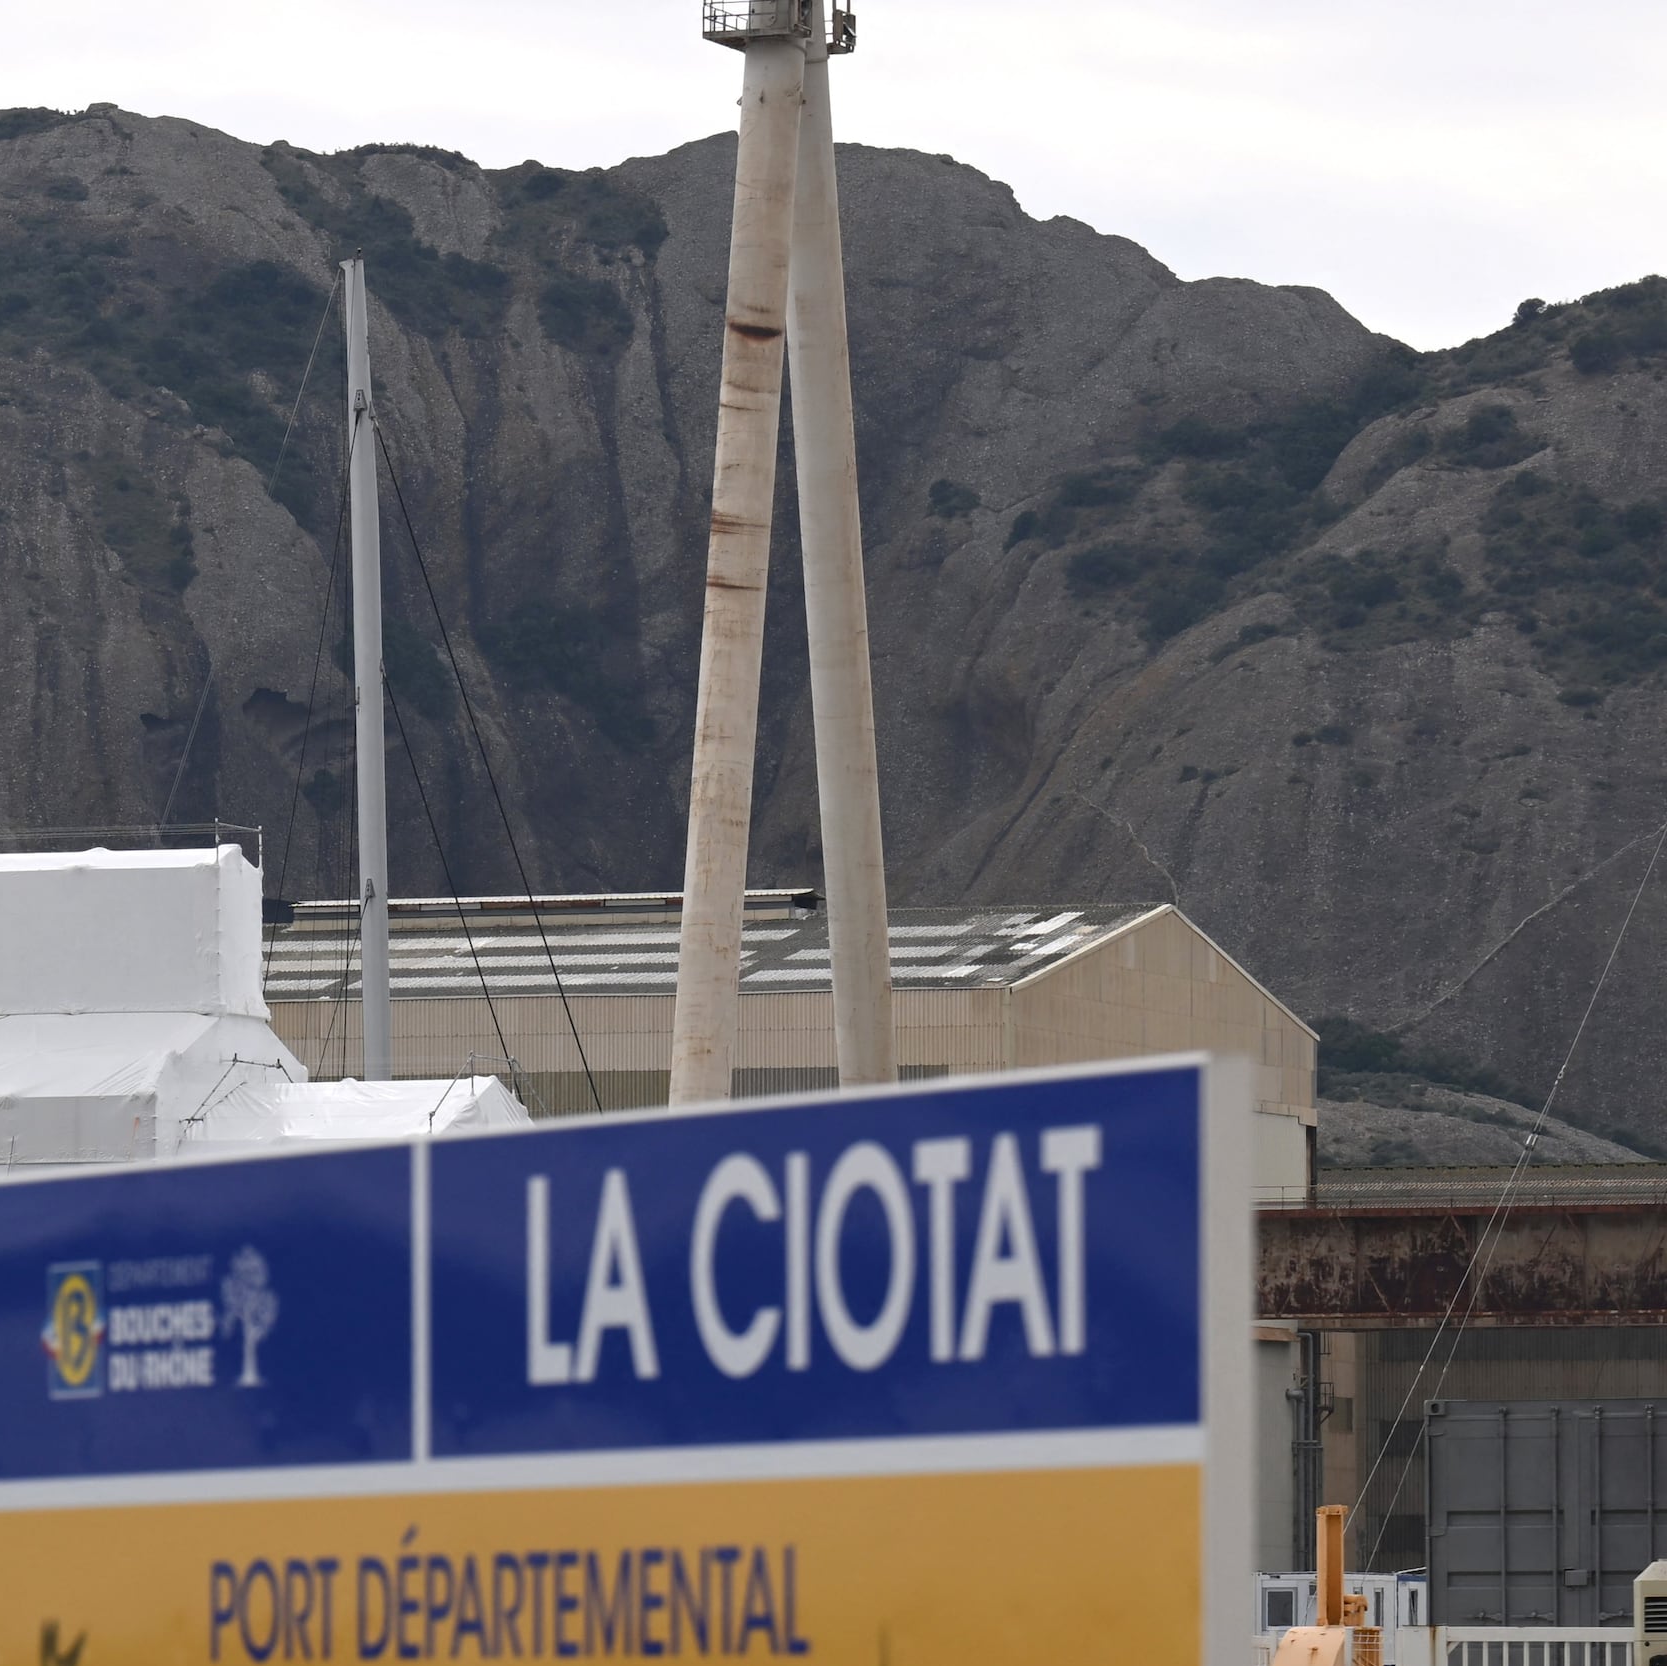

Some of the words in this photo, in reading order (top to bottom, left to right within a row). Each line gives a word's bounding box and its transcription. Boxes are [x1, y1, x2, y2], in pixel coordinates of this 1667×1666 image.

[526, 1167, 660, 1386] LA
[689, 1125, 1102, 1379] CIOTAT
[209, 1556, 341, 1663] PORT
[357, 1526, 812, 1660] DÉPARTEMENTAL
